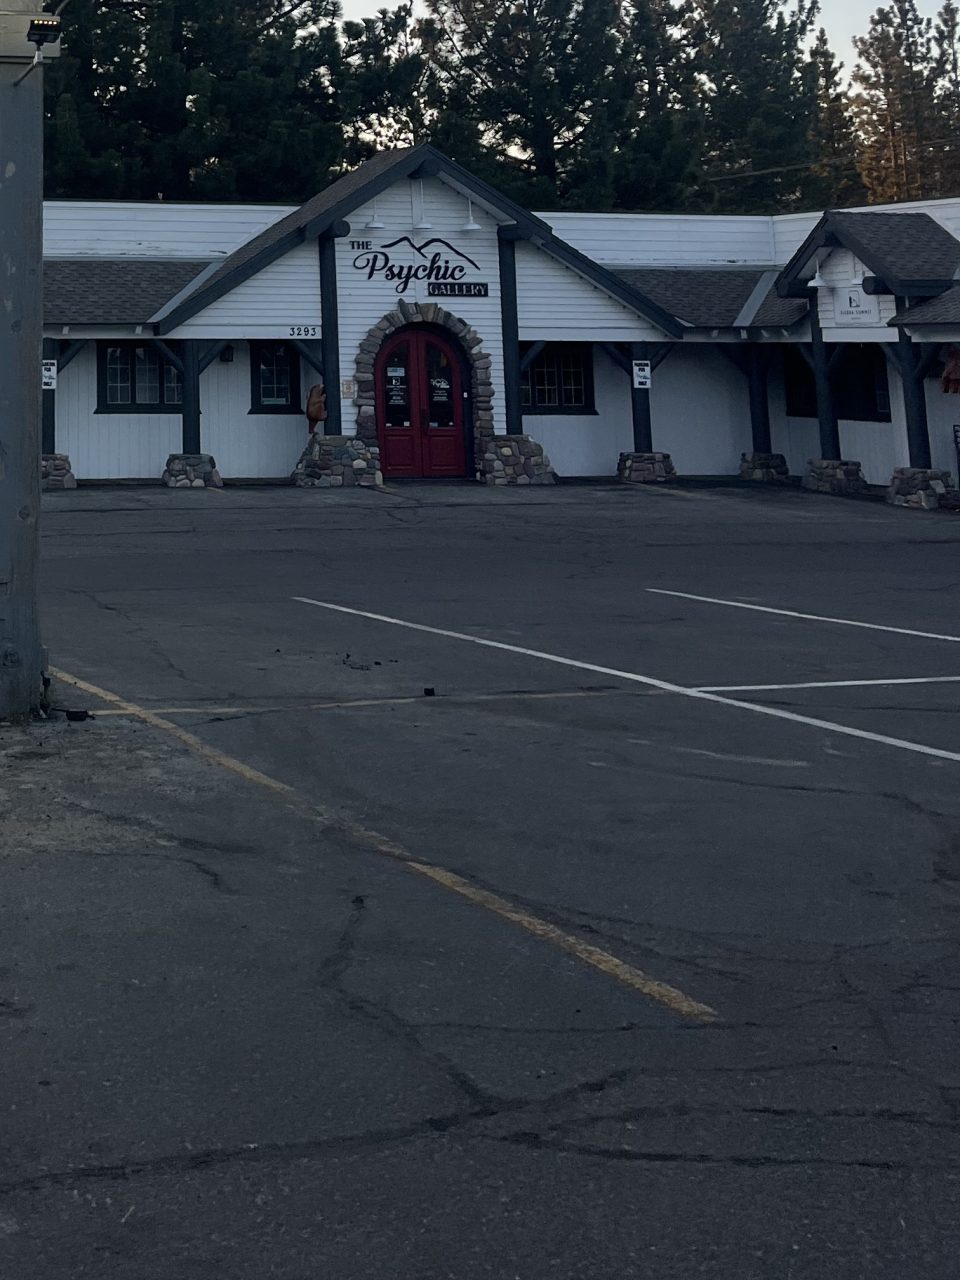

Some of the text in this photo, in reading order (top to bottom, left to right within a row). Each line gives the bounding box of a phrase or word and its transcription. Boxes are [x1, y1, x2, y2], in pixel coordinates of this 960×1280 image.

[349, 240, 372, 250] THE
[352, 251, 467, 294] Psychic
[429, 283, 487, 295] GALLERY
[289, 327, 317, 337] 3293
